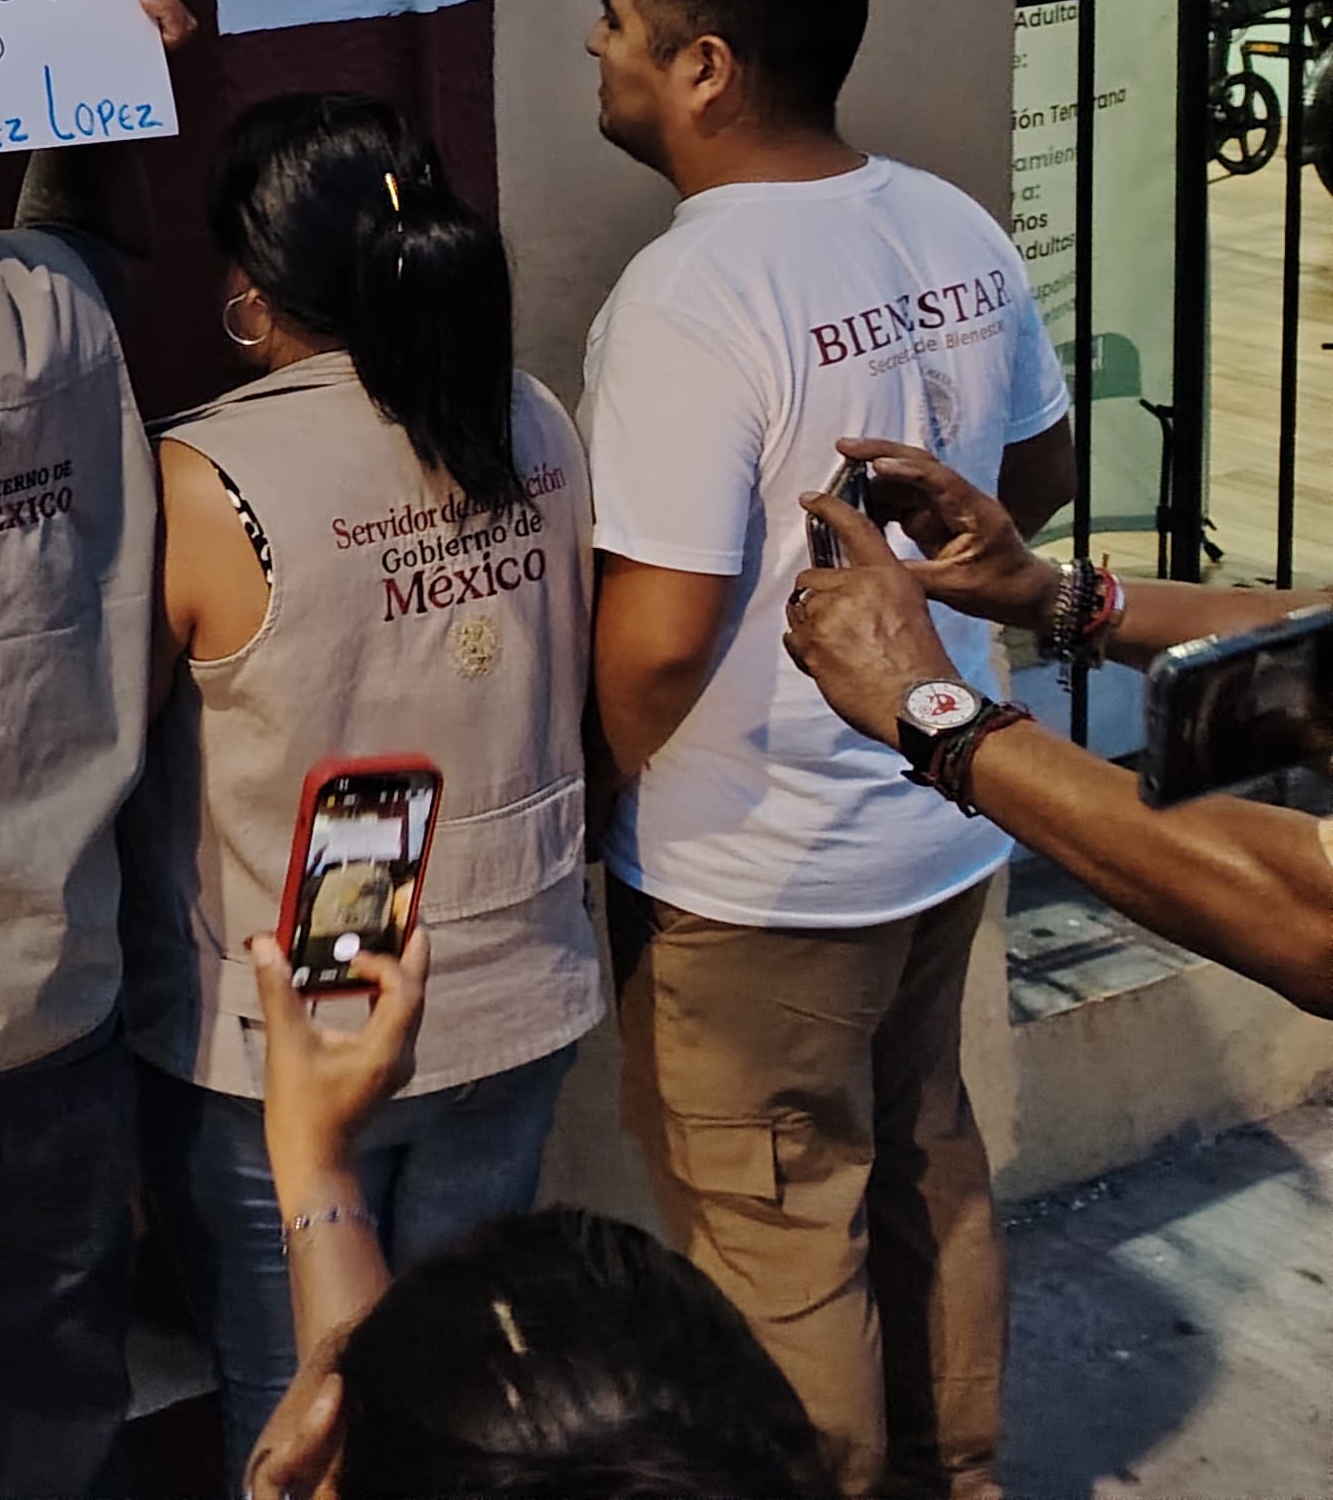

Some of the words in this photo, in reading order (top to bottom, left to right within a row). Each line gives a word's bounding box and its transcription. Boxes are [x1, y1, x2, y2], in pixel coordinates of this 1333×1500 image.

[43, 64, 165, 141] LOPEZ
[52, 460, 74, 482] DE
[332, 504, 439, 551] Servidor
[381, 524, 508, 575] Gobierno
[514, 509, 544, 538] de
[382, 547, 547, 623] México
